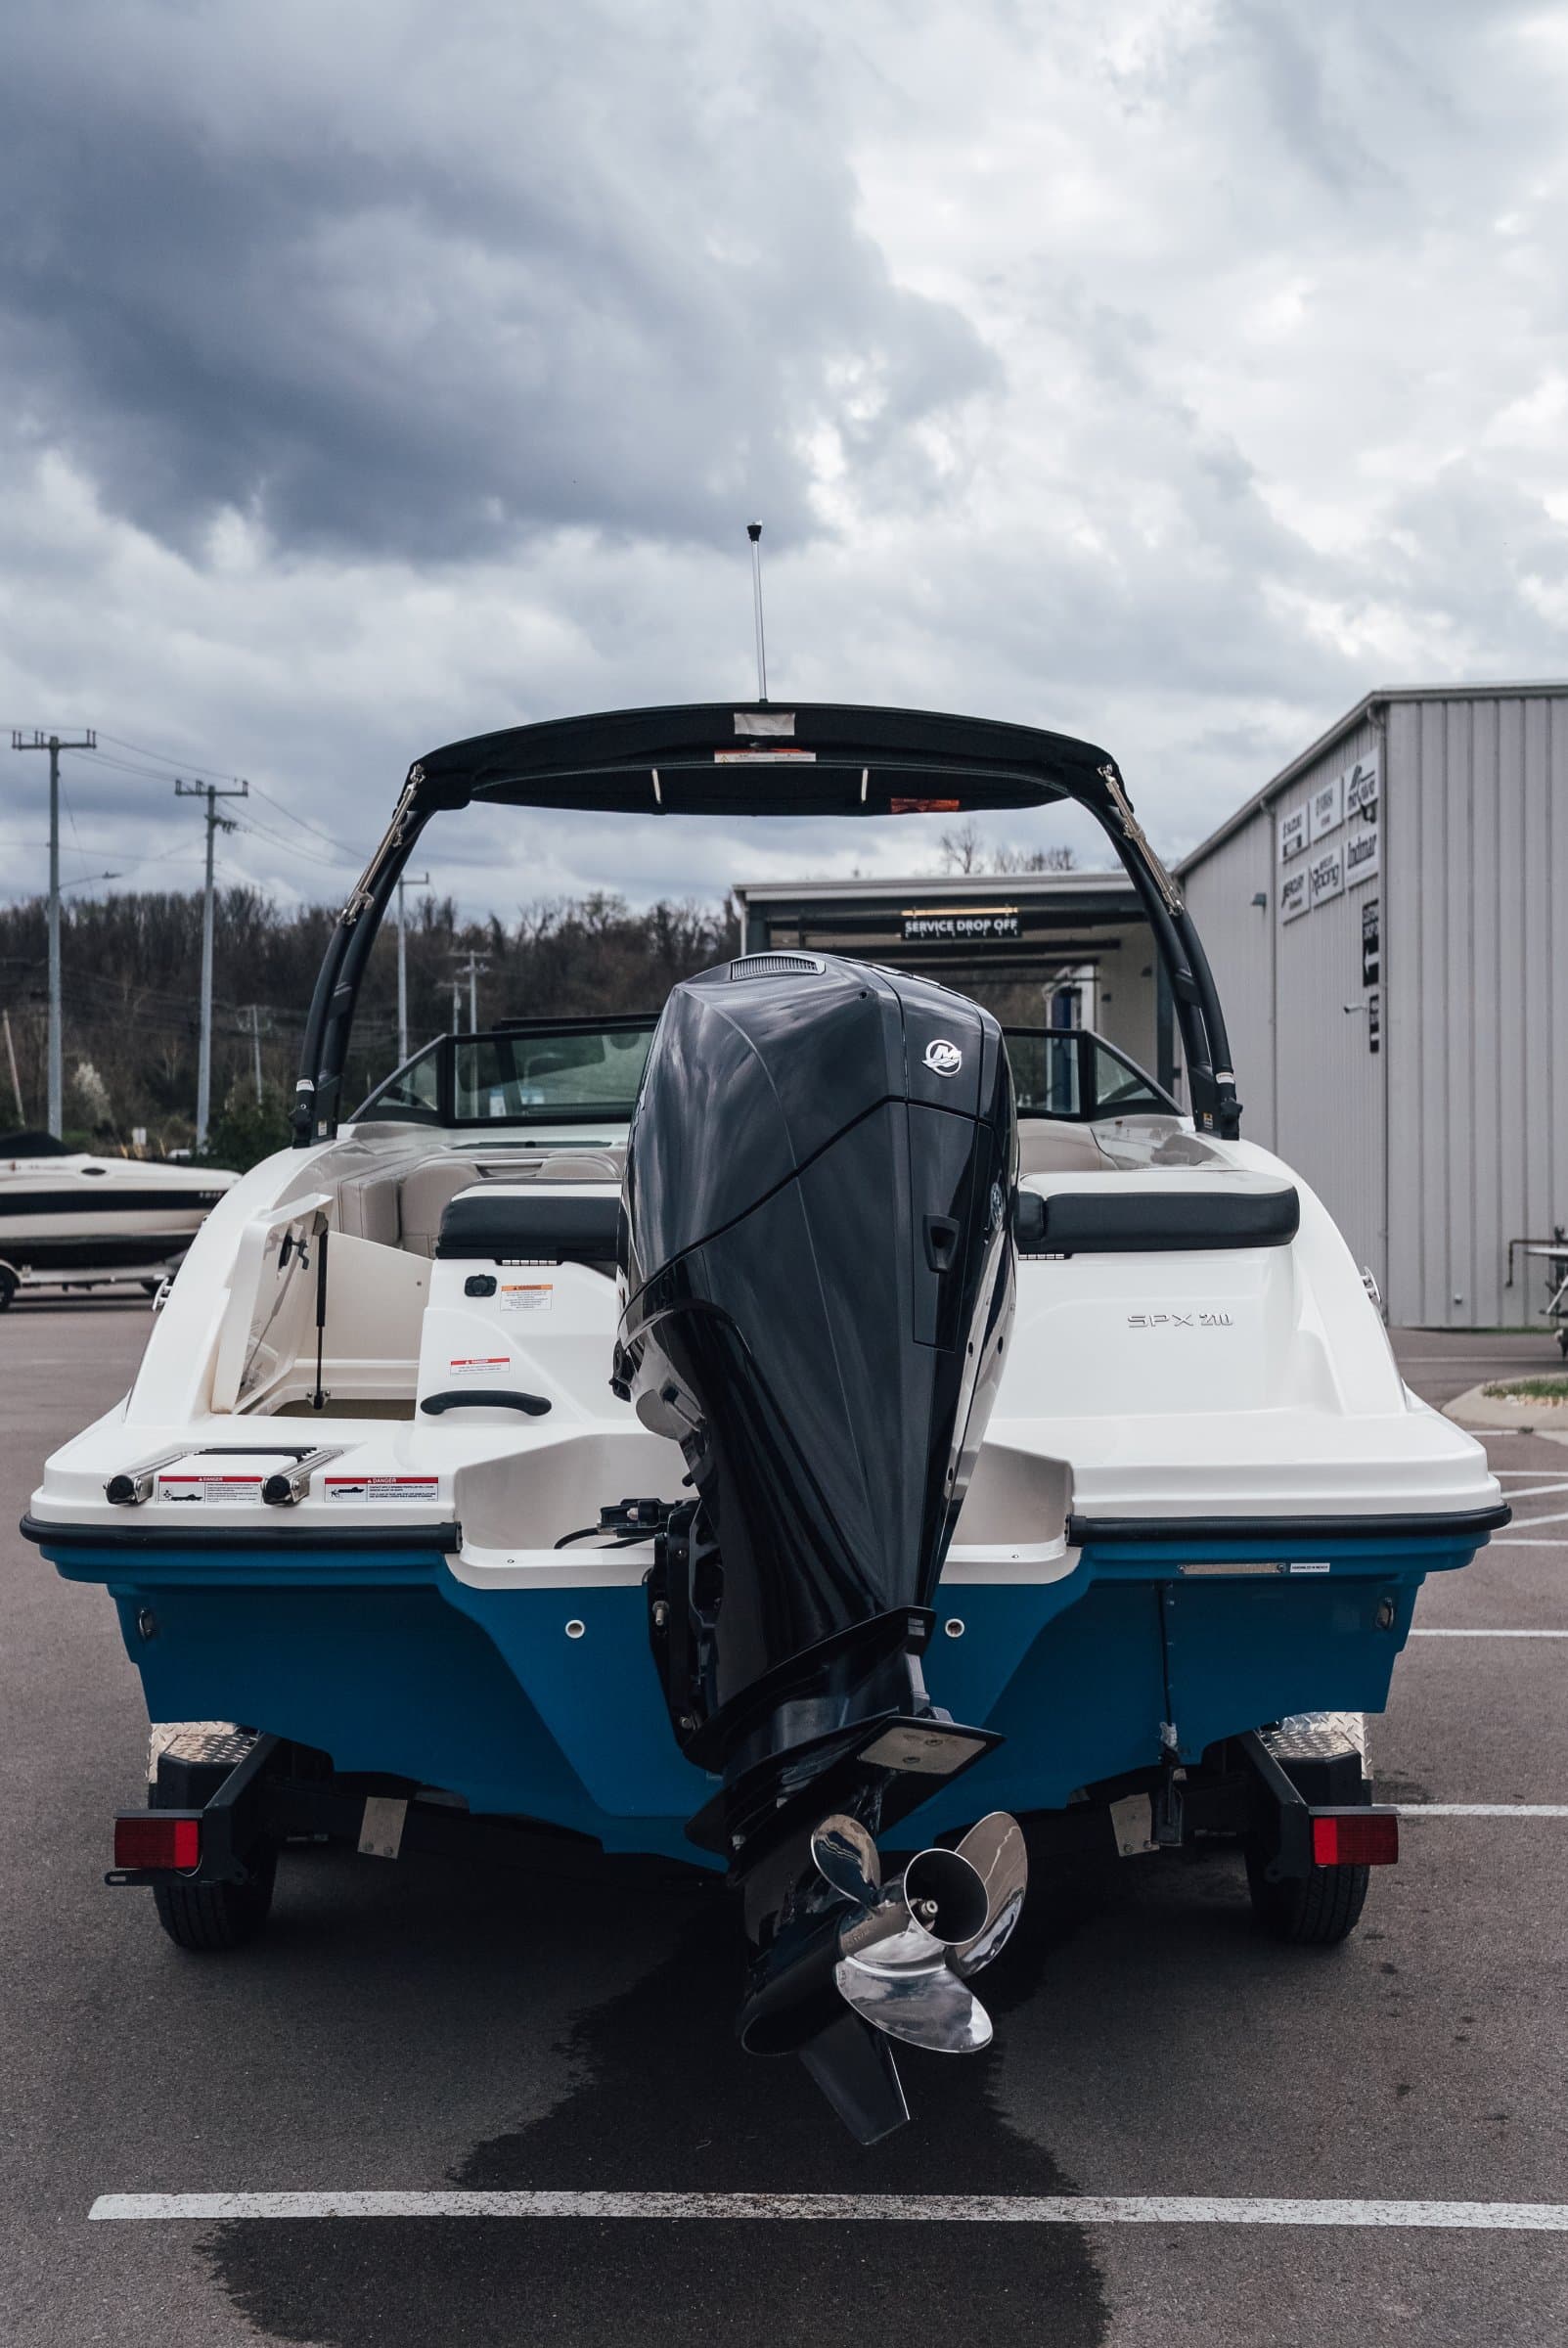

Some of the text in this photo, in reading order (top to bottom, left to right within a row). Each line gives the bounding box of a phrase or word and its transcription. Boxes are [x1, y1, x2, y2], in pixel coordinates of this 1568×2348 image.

[905, 918, 1018, 933] SERVICE DROP OFF
[1128, 1314, 1232, 1329] SPX 210
